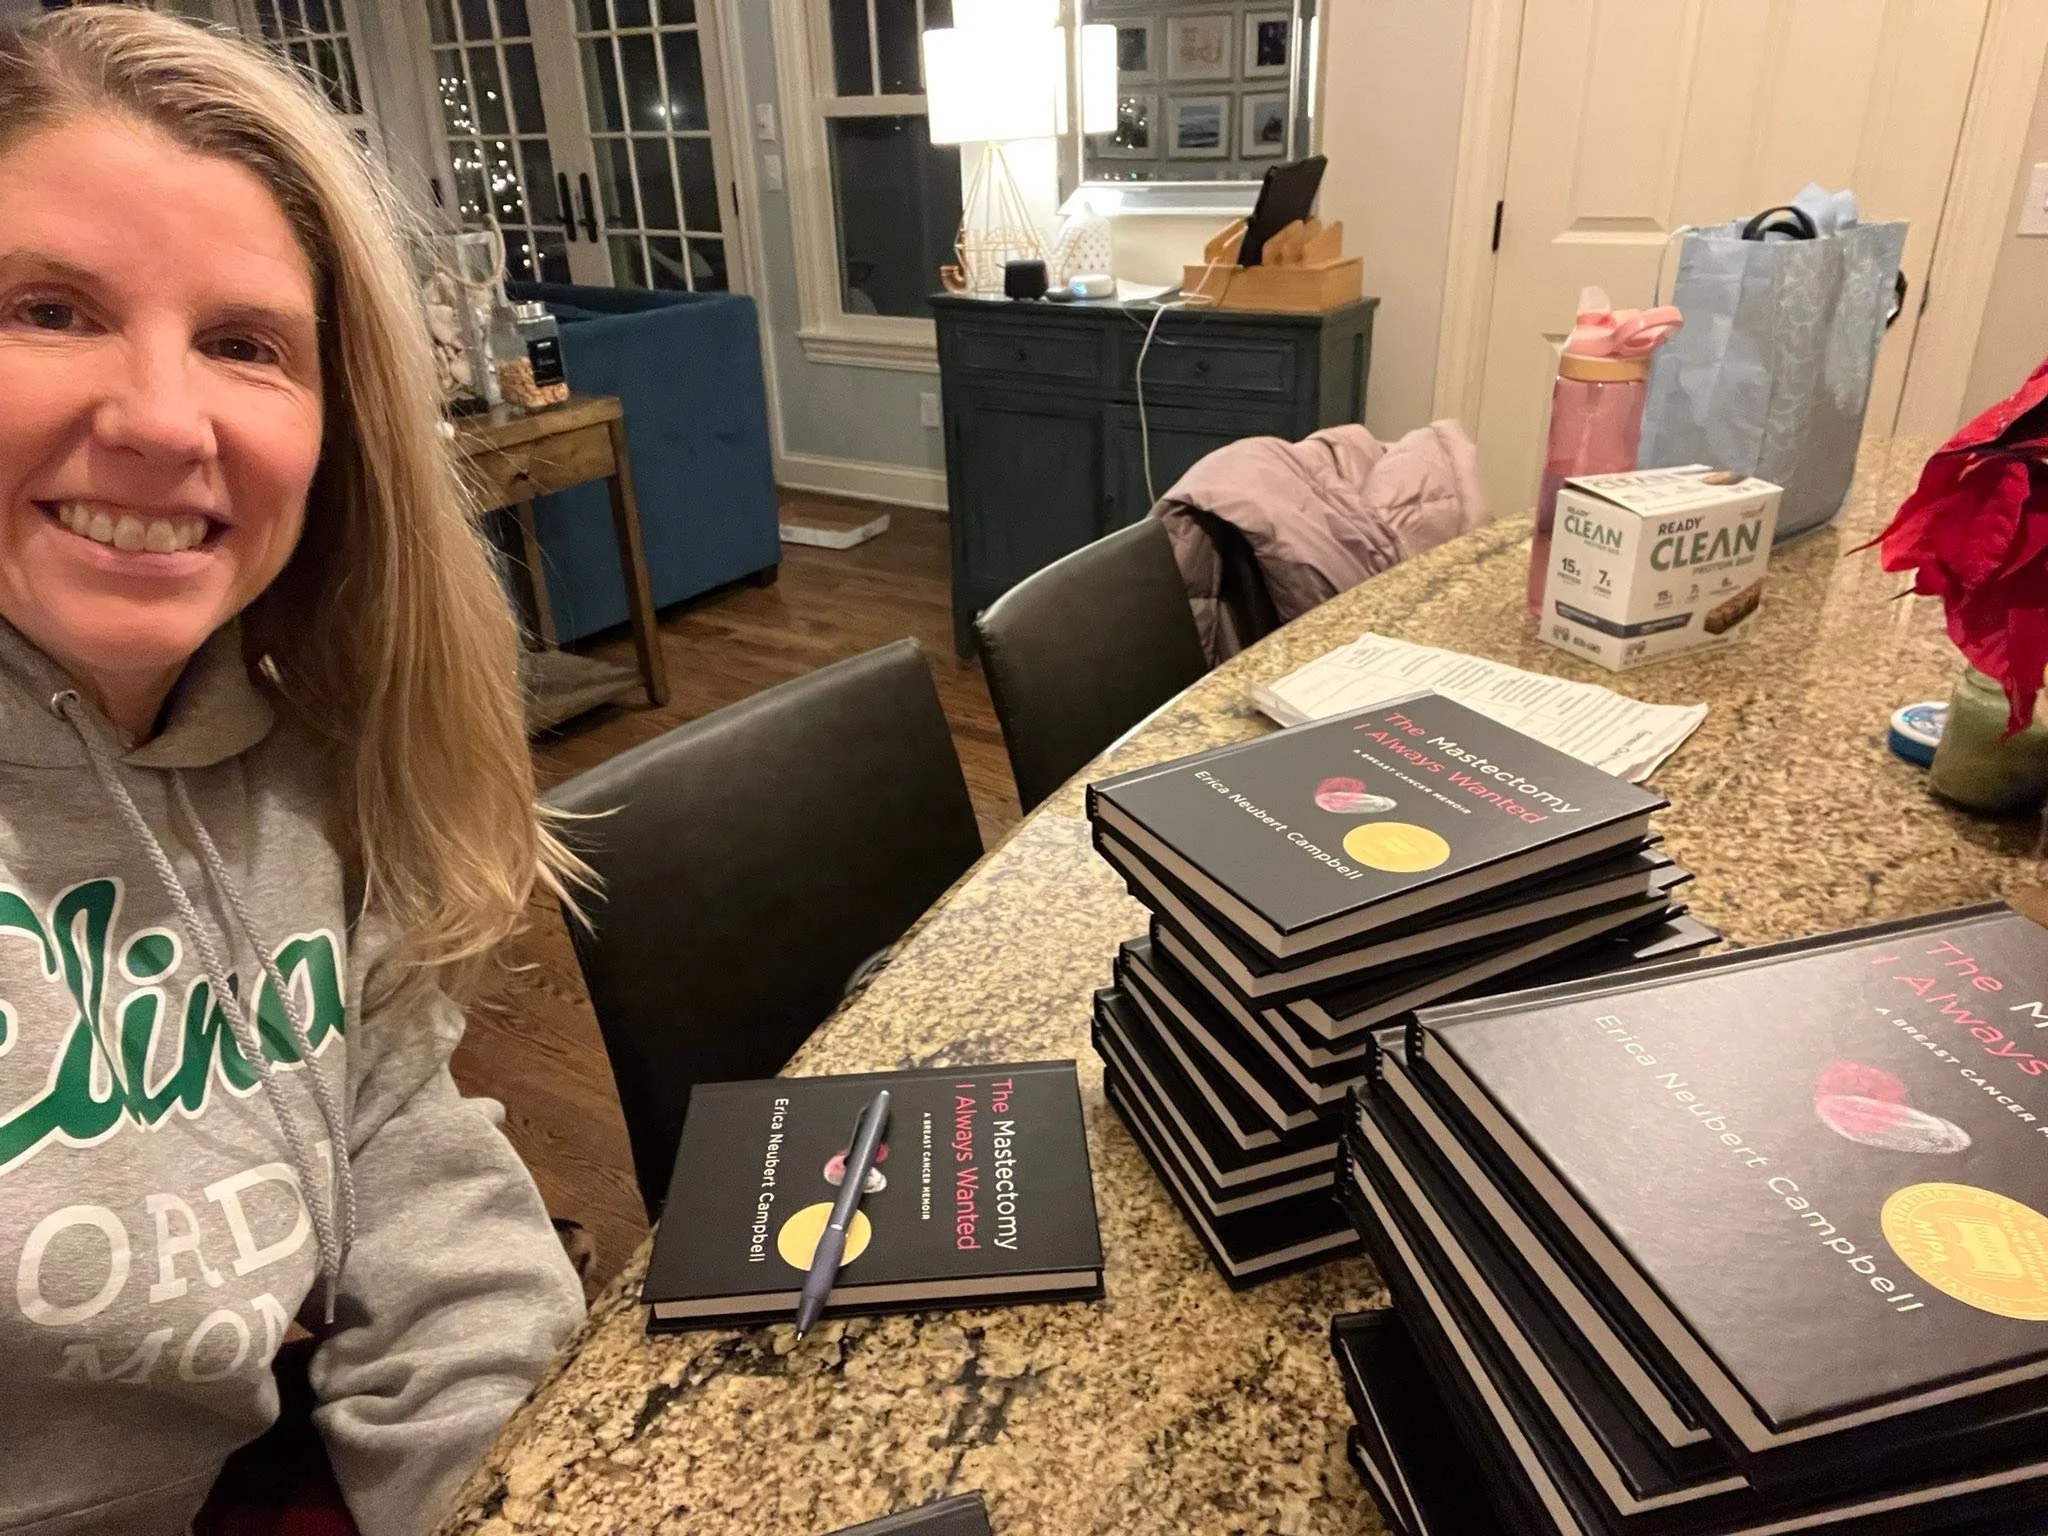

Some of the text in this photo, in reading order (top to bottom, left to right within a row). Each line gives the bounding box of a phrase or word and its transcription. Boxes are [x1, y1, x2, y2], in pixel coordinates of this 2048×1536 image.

[1564, 515, 1623, 549] CLEAN
[1650, 520, 1762, 572] CLEAN
[1658, 517, 1703, 536] READY
[1361, 753, 1396, 773] BREAST
[1395, 772, 1433, 794] CANCER
[1432, 792, 1472, 815] MEMOIR
[1364, 731, 1446, 774] Always
[1447, 771, 1549, 824] Wanted
[1384, 712, 1426, 737] The
[1426, 736, 1582, 814] Mastectomy
[1194, 770, 1364, 880] Erica Neubert Campbell
[1926, 939, 2004, 992] The
[1871, 955, 1901, 965] I
[1893, 976, 2048, 1076] Always
[1875, 1006, 2037, 1122] A BREAST CANCER
[922, 1120, 931, 1150] BREAST
[952, 1095, 977, 1162] Always
[991, 1078, 1020, 1251] The Mastectomy
[1594, 1014, 1657, 1067] Erica
[1655, 1071, 1769, 1169] Neubert
[1767, 1176, 1925, 1313] Campbell
[749, 1098, 789, 1262] Erica Neubert Campbell
[921, 1186, 931, 1220] MEMOIR
[922, 1151, 931, 1185] CANCER
[955, 1166, 982, 1250] Wanted
